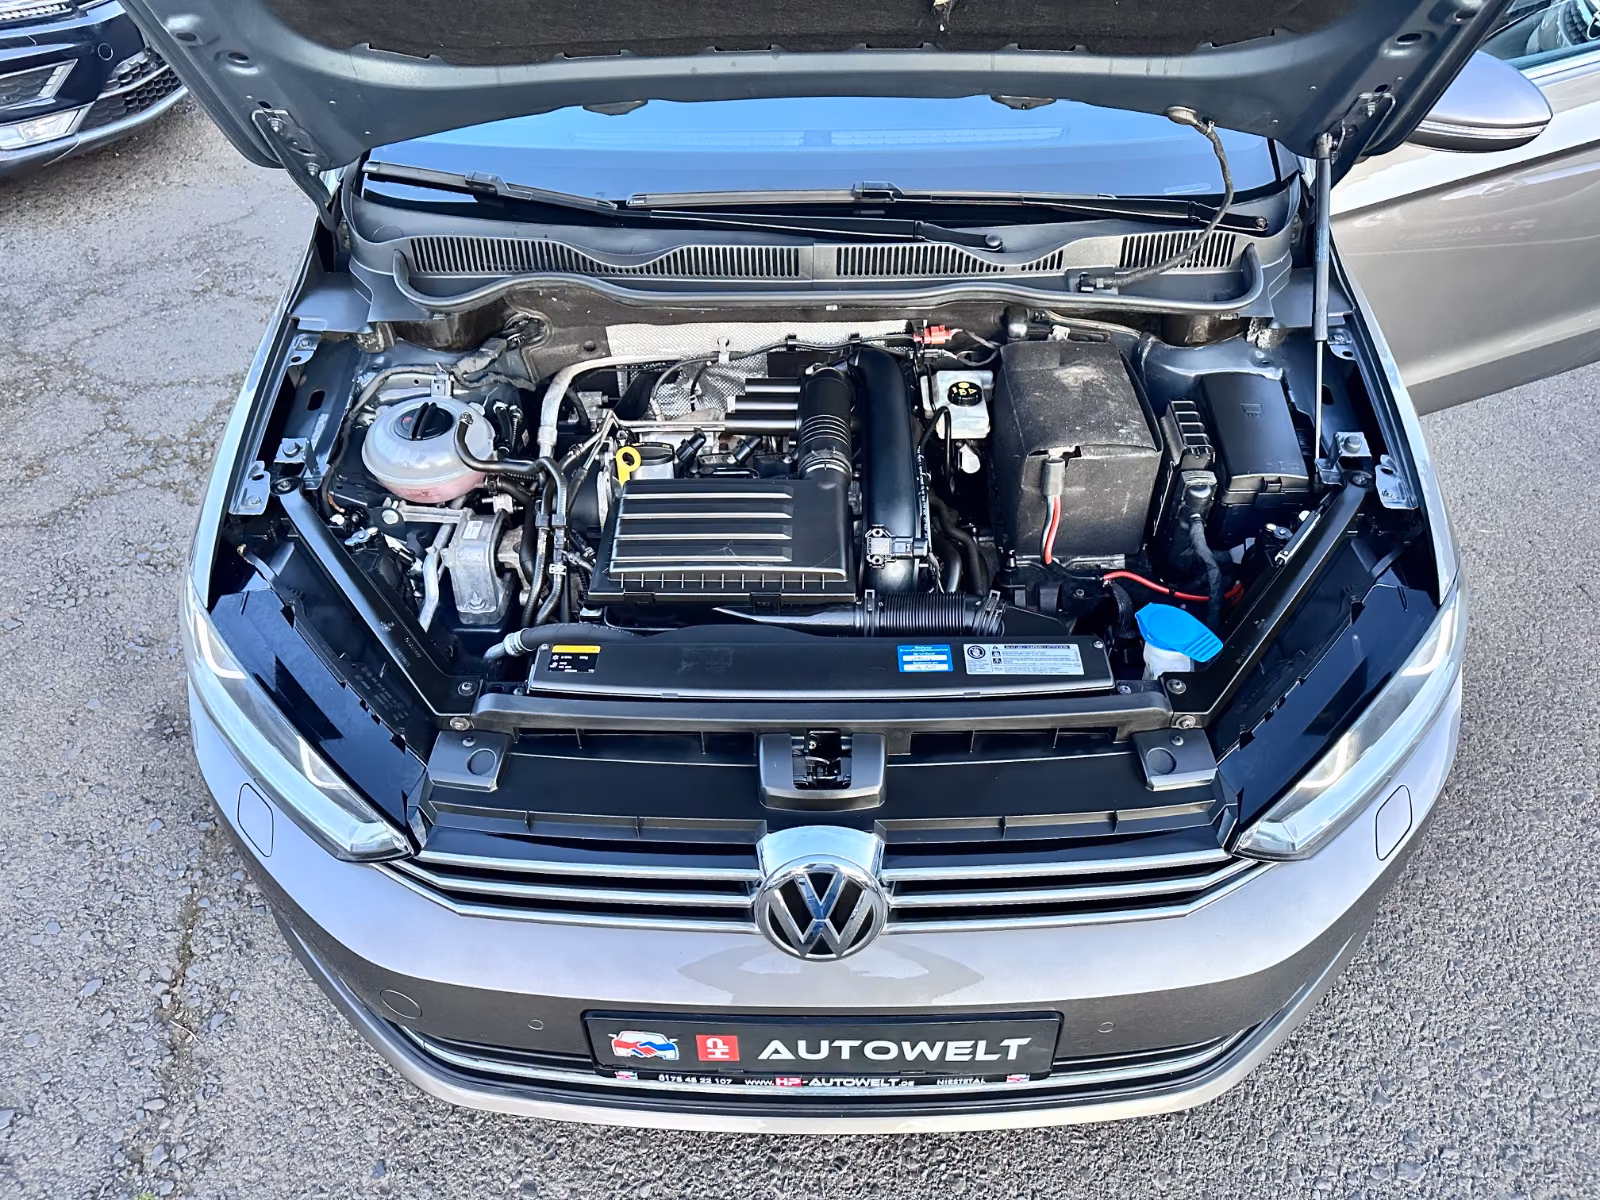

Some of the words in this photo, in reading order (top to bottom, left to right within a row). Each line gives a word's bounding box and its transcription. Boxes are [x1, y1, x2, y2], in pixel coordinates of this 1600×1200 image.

[766, 868, 876, 958] VW
[757, 1038, 1032, 1061] AUTOWELT
[699, 1076, 712, 1084] 22
[714, 1077, 733, 1085] 107
